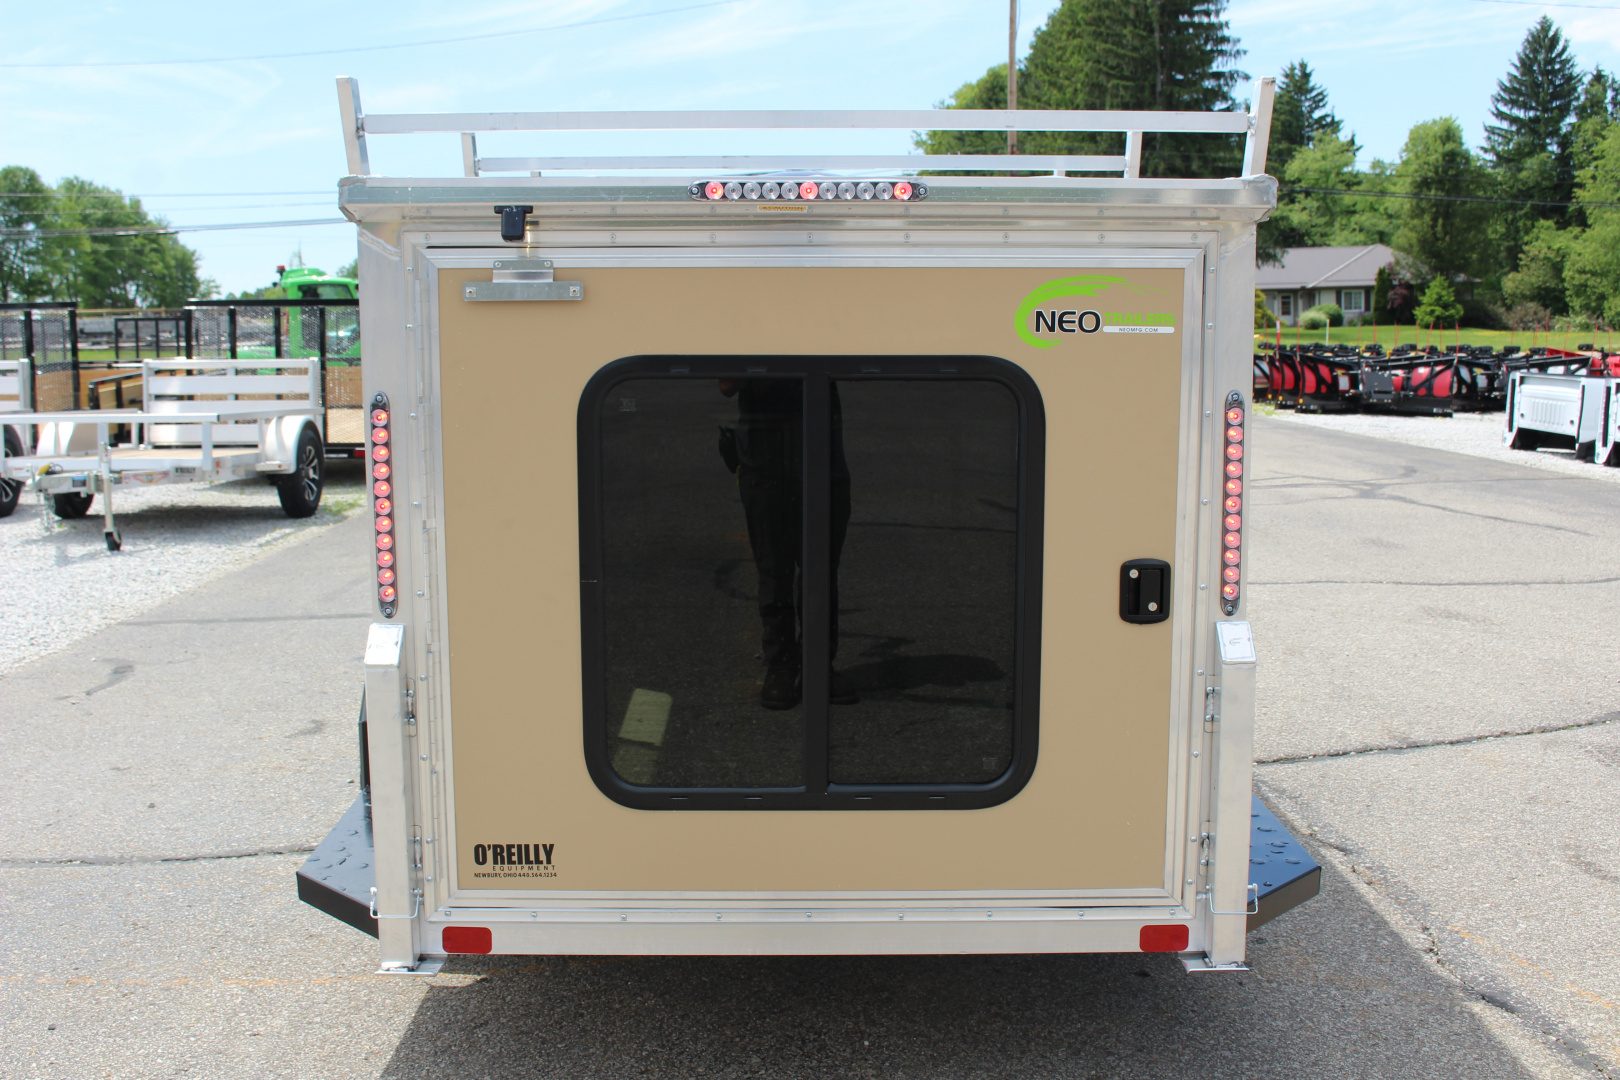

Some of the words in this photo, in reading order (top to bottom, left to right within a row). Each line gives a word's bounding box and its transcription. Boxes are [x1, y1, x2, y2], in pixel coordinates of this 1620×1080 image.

[1034, 310, 1101, 334] NEO
[1103, 312, 1176, 326] TRAILERS
[474, 843, 555, 866] O'REILLY
